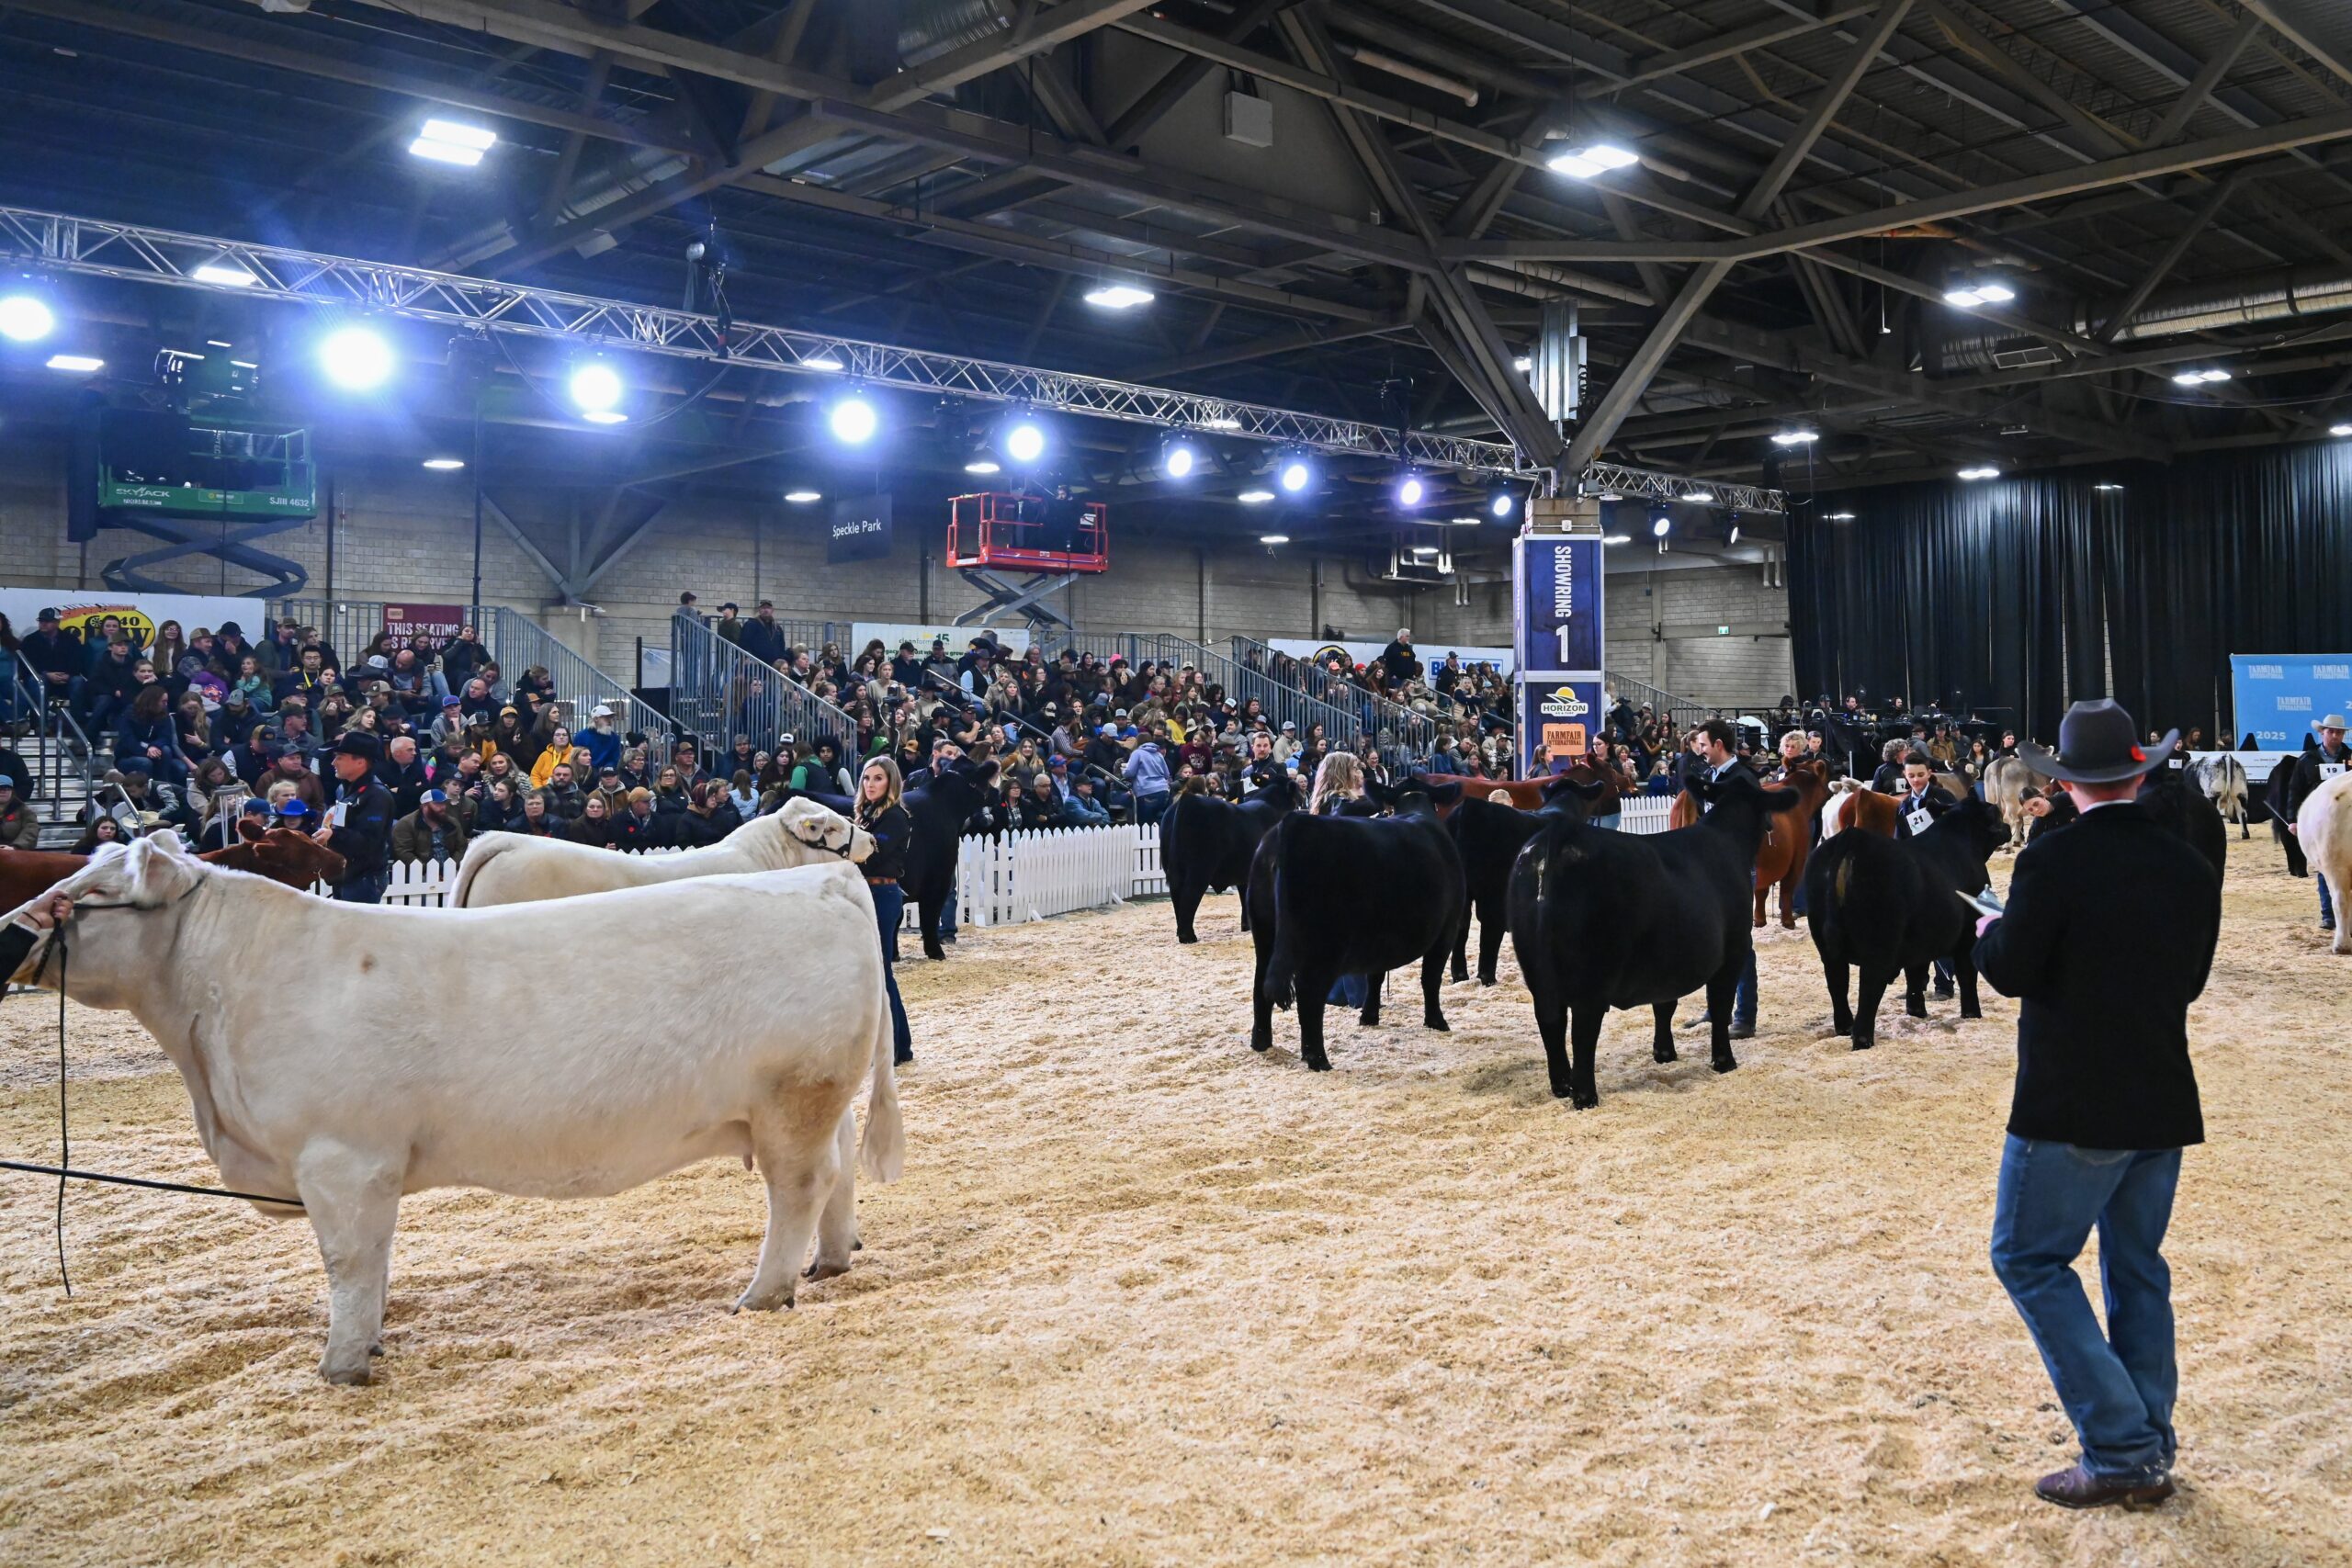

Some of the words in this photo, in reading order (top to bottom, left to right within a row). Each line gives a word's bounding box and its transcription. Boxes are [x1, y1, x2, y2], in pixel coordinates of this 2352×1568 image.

[116, 487, 170, 497] SKYJACK
[832, 522, 860, 540] Speckle
[862, 518, 882, 533] Park
[1555, 546, 1572, 618] SHOWRING
[119, 616, 141, 626] 40
[387, 622, 413, 636] THIS
[415, 623, 459, 636] SEATING
[936, 634, 950, 642] 15
[1555, 625, 1568, 662] 1
[1547, 731, 1581, 739] FARMFAIR
[2256, 731, 2286, 739] 2025
[1913, 815, 1924, 825] 21
